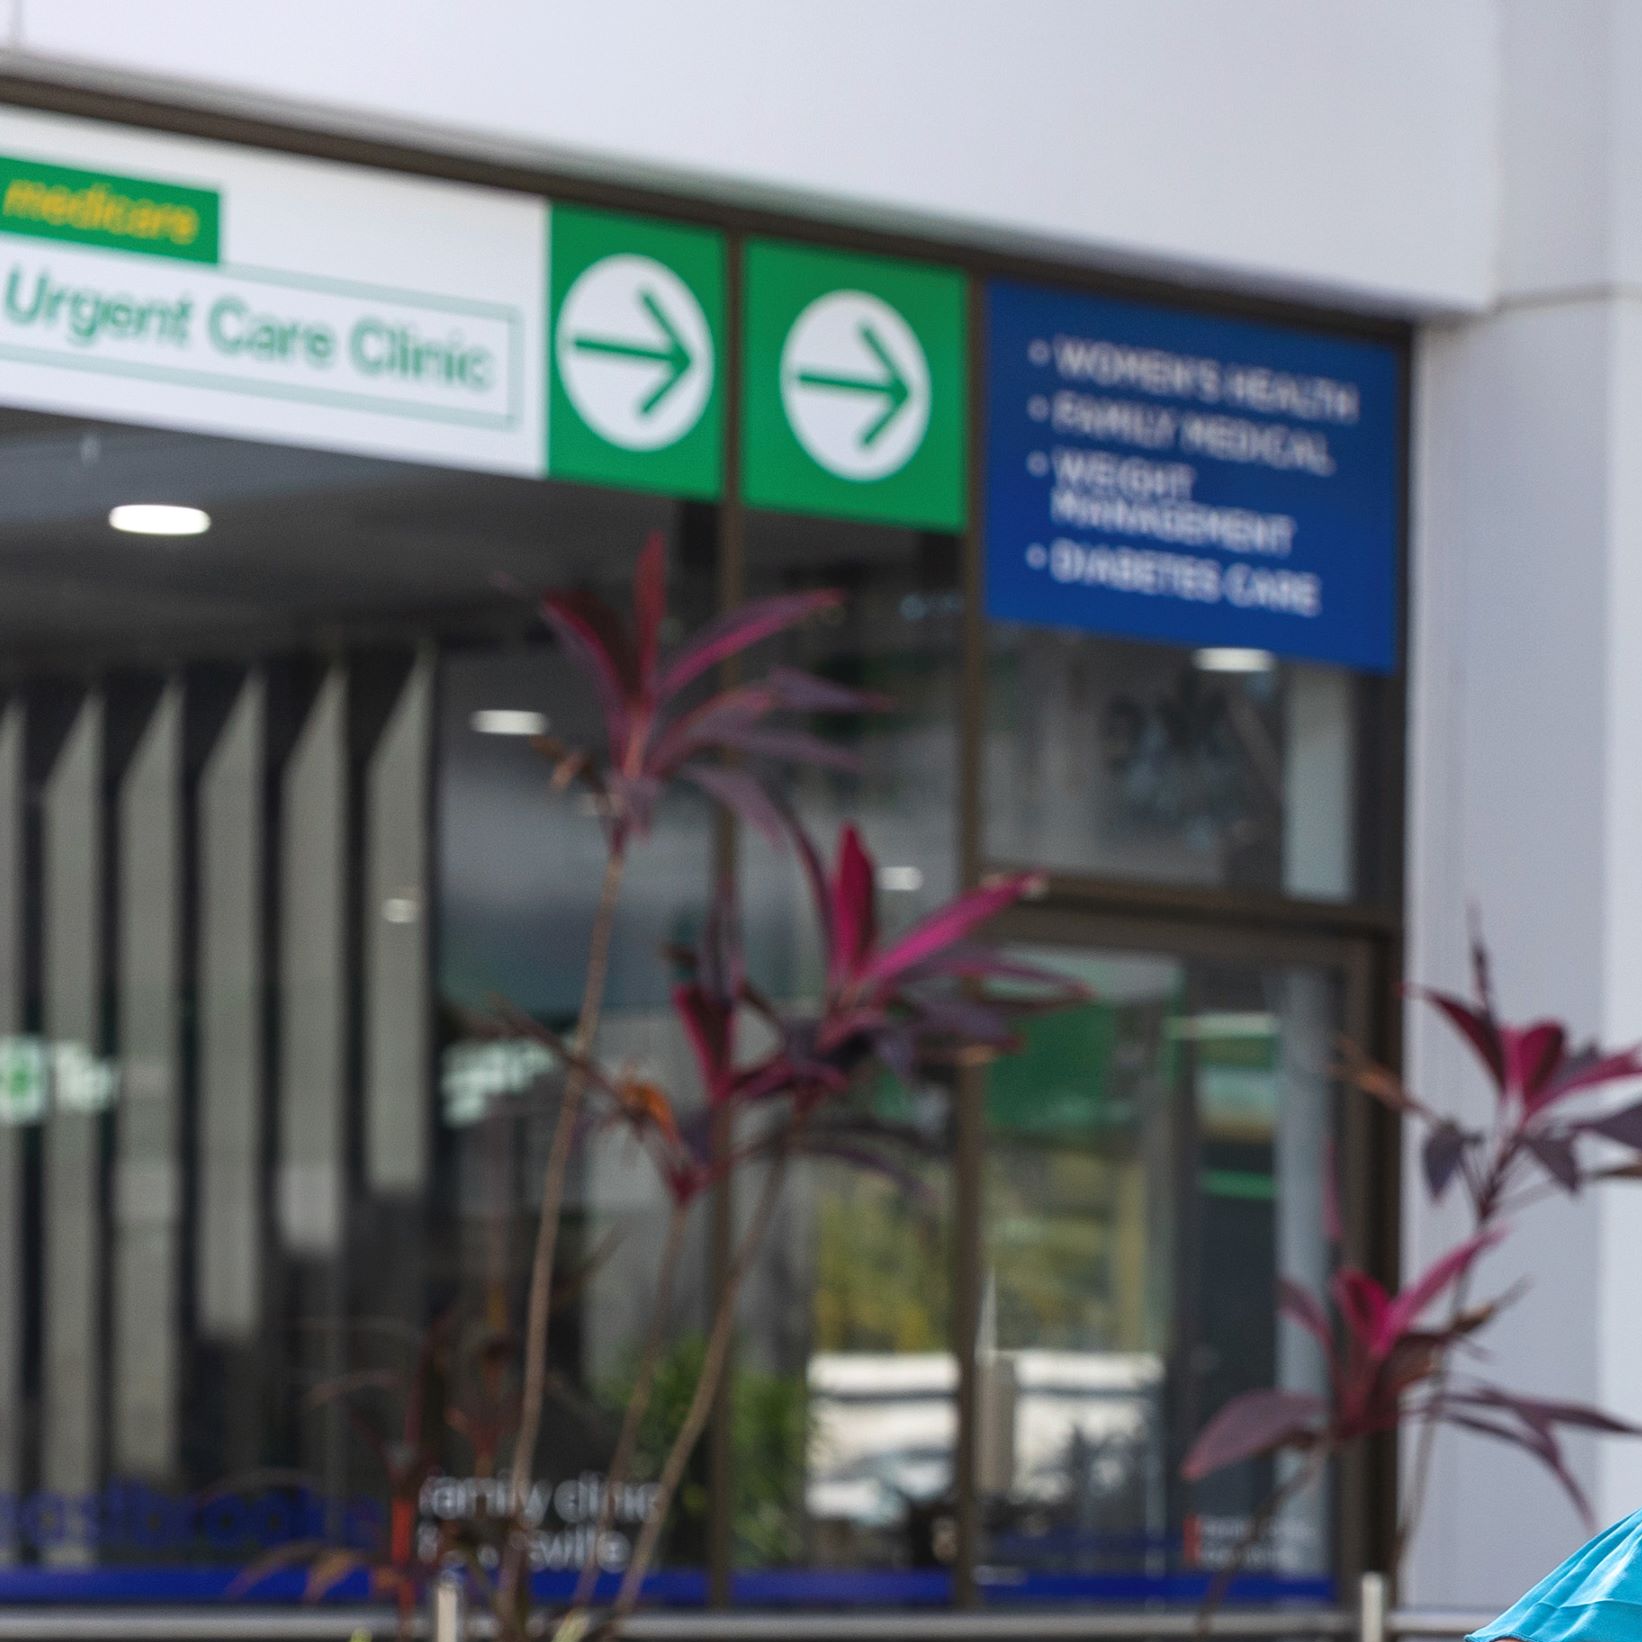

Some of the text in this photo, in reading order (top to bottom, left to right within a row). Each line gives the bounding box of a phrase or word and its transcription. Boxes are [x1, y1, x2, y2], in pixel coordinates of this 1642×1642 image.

[3, 179, 198, 245] medicare
[2, 260, 496, 395] Urgent Care Clinic
[1222, 362, 1360, 424] HEALTH
[1050, 390, 1337, 477] FAMILY MEDICAL
[1050, 447, 1197, 500] WEIGHT
[1051, 490, 1296, 558] MANAGEMENT
[1050, 538, 1321, 617] DIABETES CARE
